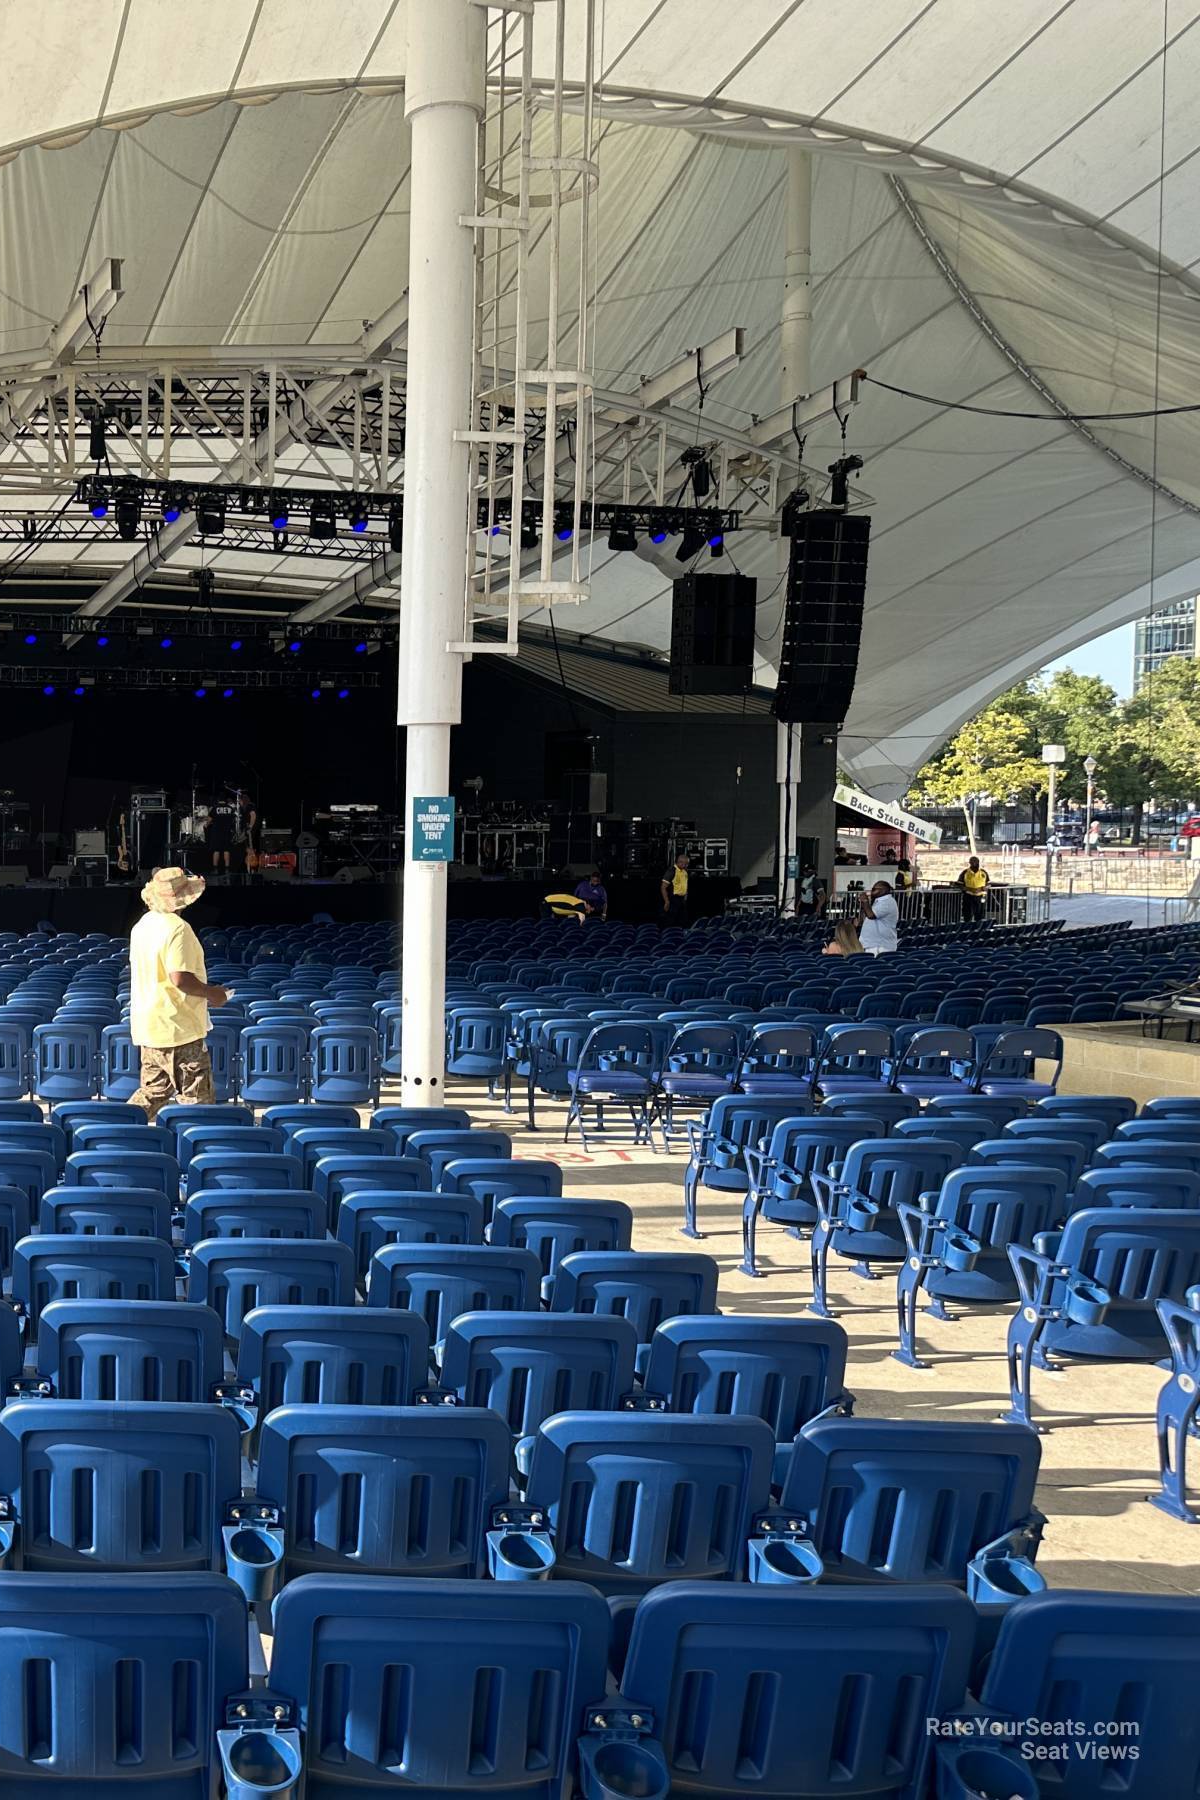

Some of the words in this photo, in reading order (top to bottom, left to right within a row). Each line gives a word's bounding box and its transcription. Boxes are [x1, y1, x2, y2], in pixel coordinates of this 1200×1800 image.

[428, 805, 439, 814] NO
[416, 814, 450, 823] SMOKING
[421, 822, 445, 831] UNDER
[424, 831, 442, 840] TENT
